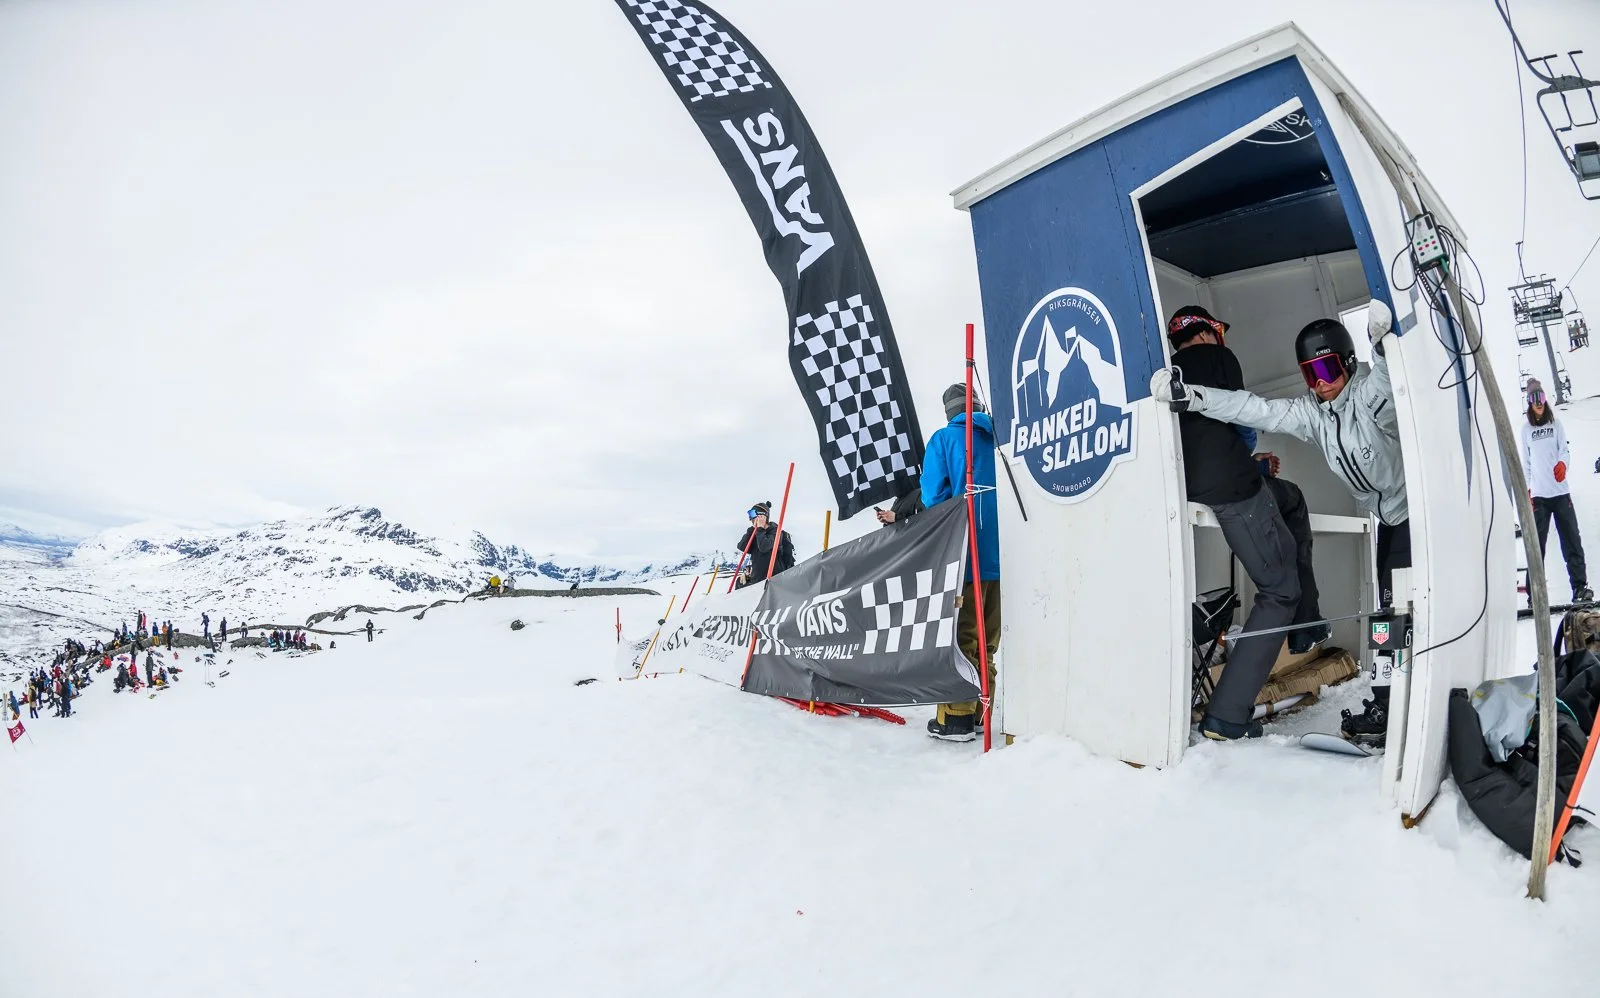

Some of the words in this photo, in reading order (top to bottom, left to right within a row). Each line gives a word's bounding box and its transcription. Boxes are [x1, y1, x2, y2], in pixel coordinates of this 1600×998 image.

[720, 111, 835, 280] VANS
[1049, 297, 1101, 325] RIKSGRÄNSEN
[1016, 398, 1097, 453] BANKED
[1041, 418, 1128, 474] SLALOM
[1052, 476, 1092, 493] SNOWBOARD
[796, 587, 852, 637] VANS
[804, 646, 824, 660] THE
[823, 643, 860, 660] WALL"
